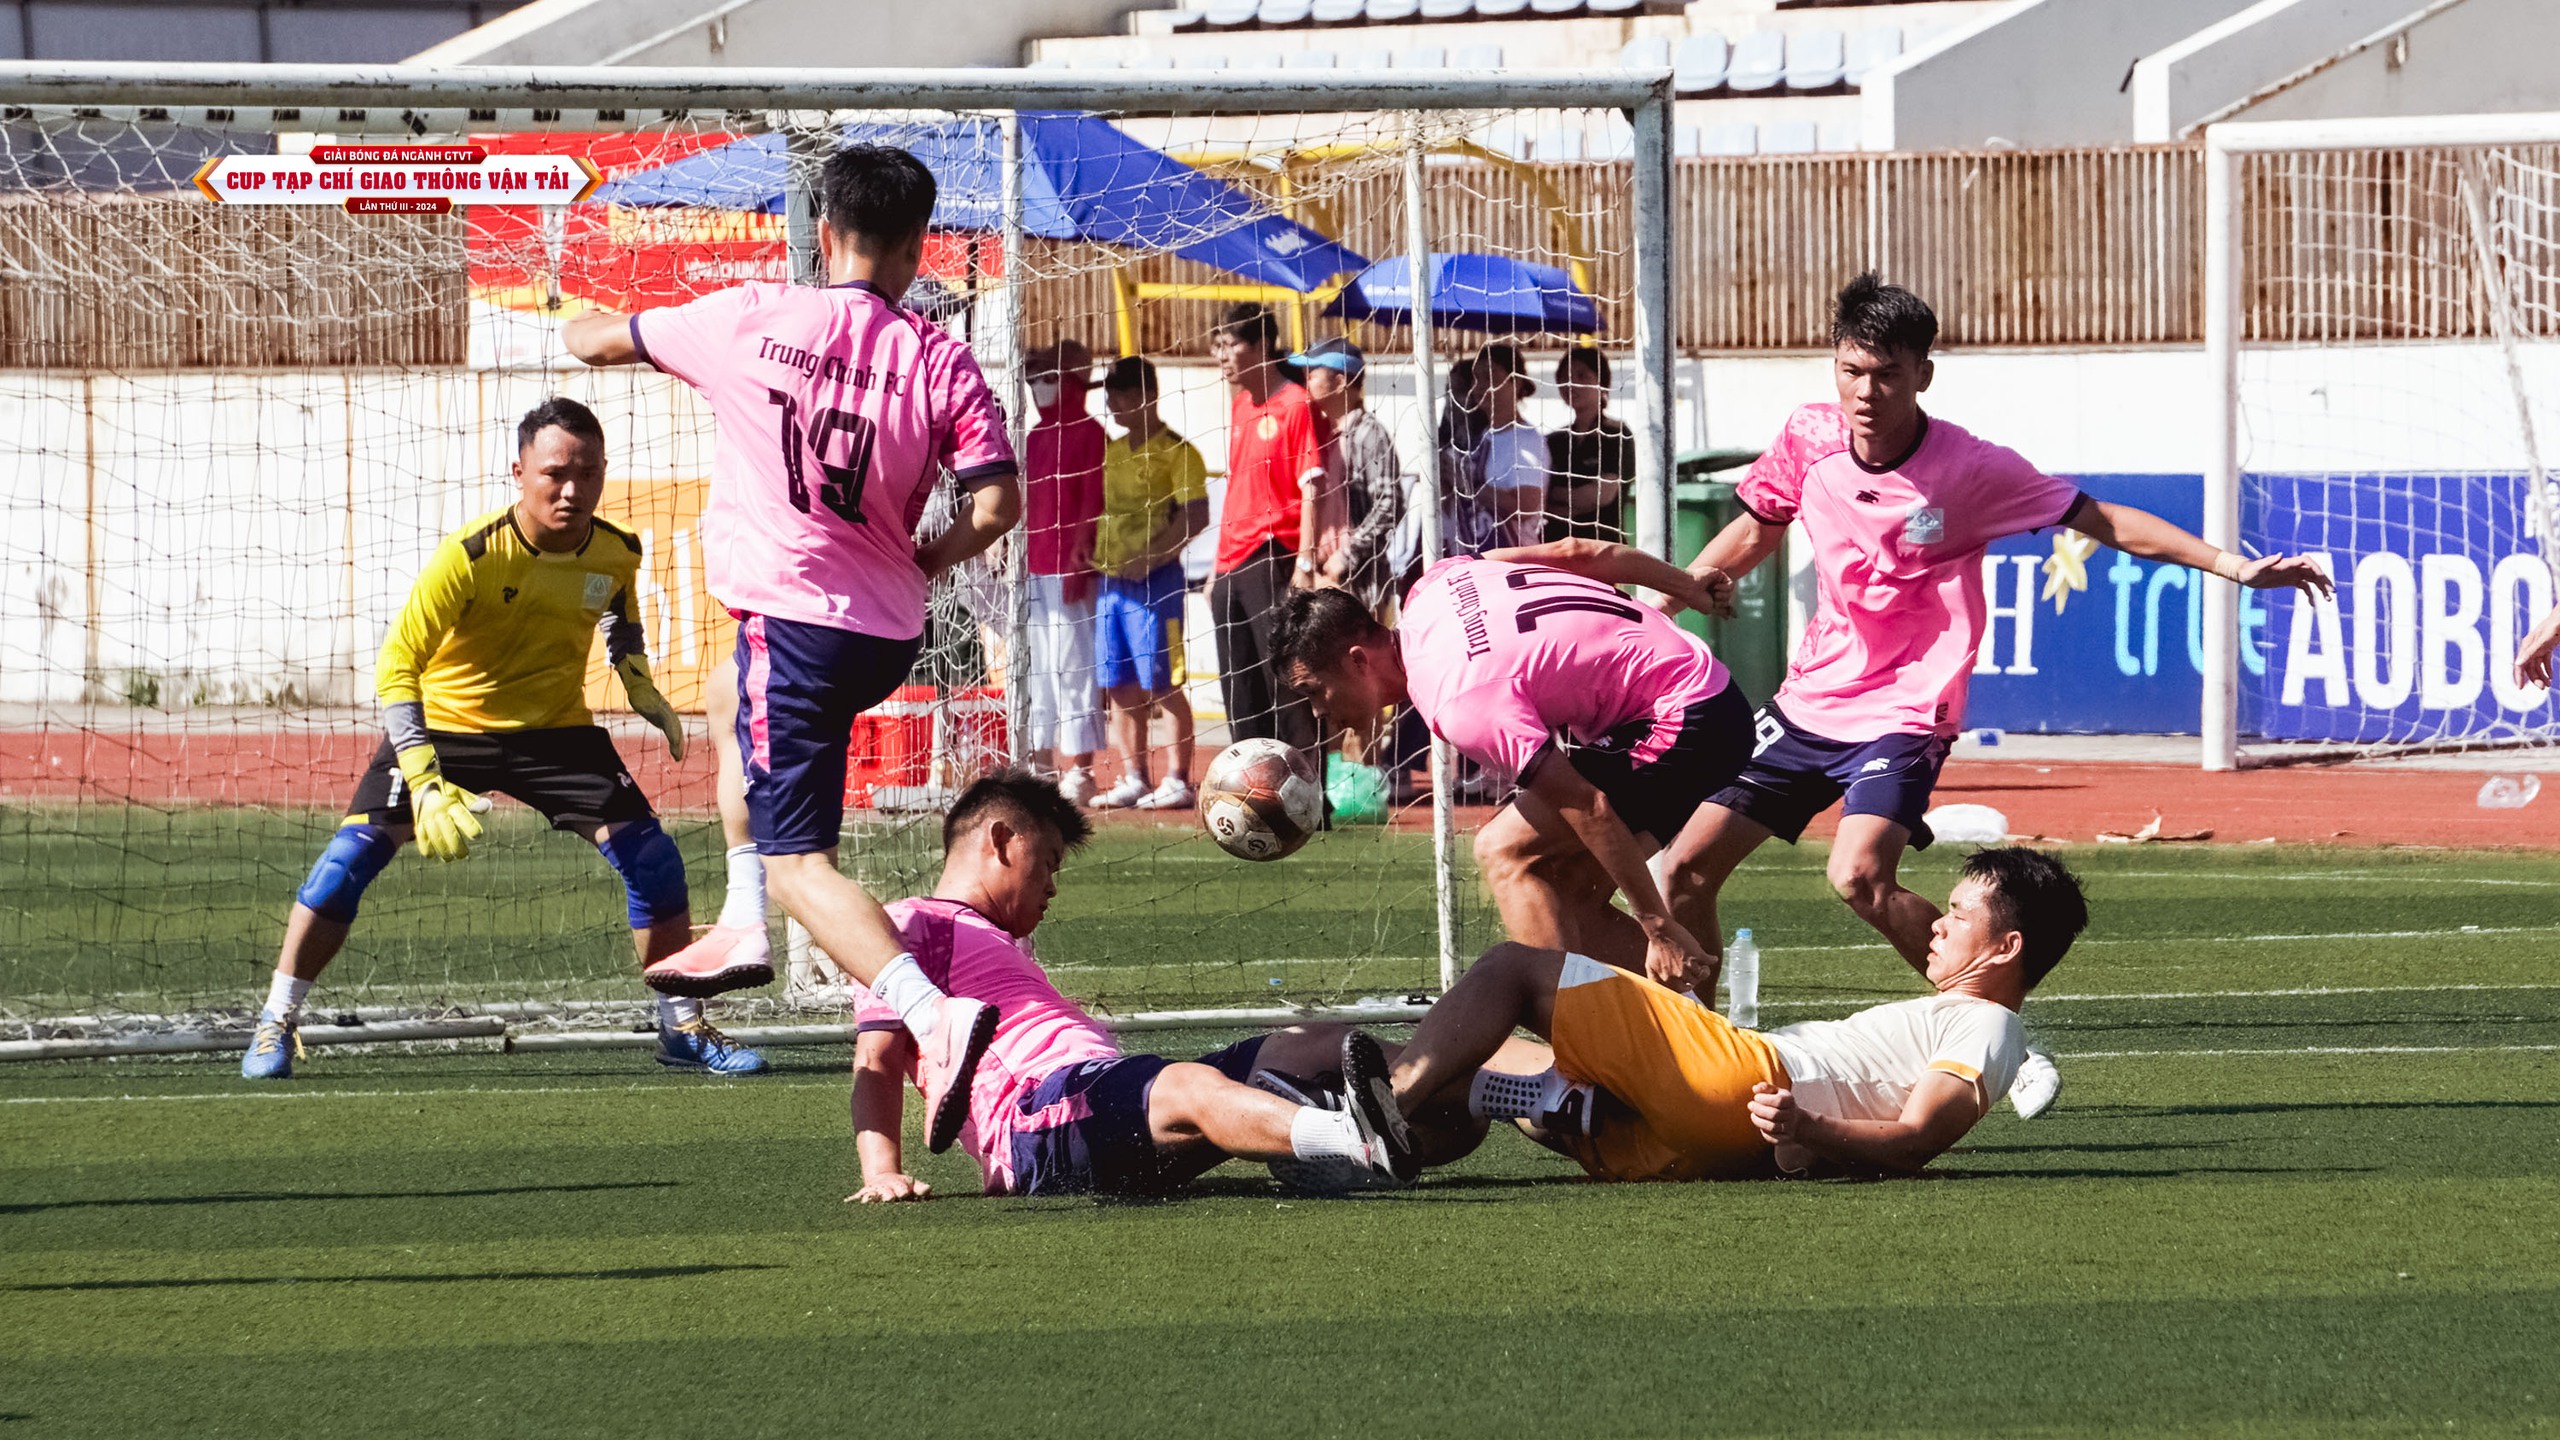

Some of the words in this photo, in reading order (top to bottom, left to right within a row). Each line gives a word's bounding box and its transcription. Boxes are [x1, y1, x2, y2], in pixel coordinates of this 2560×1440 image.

[759, 336, 820, 379] Trung
[823, 357, 876, 391] Chính
[883, 371, 907, 397] FC
[768, 387, 876, 524] 19
[1464, 608, 1491, 662] Trung
